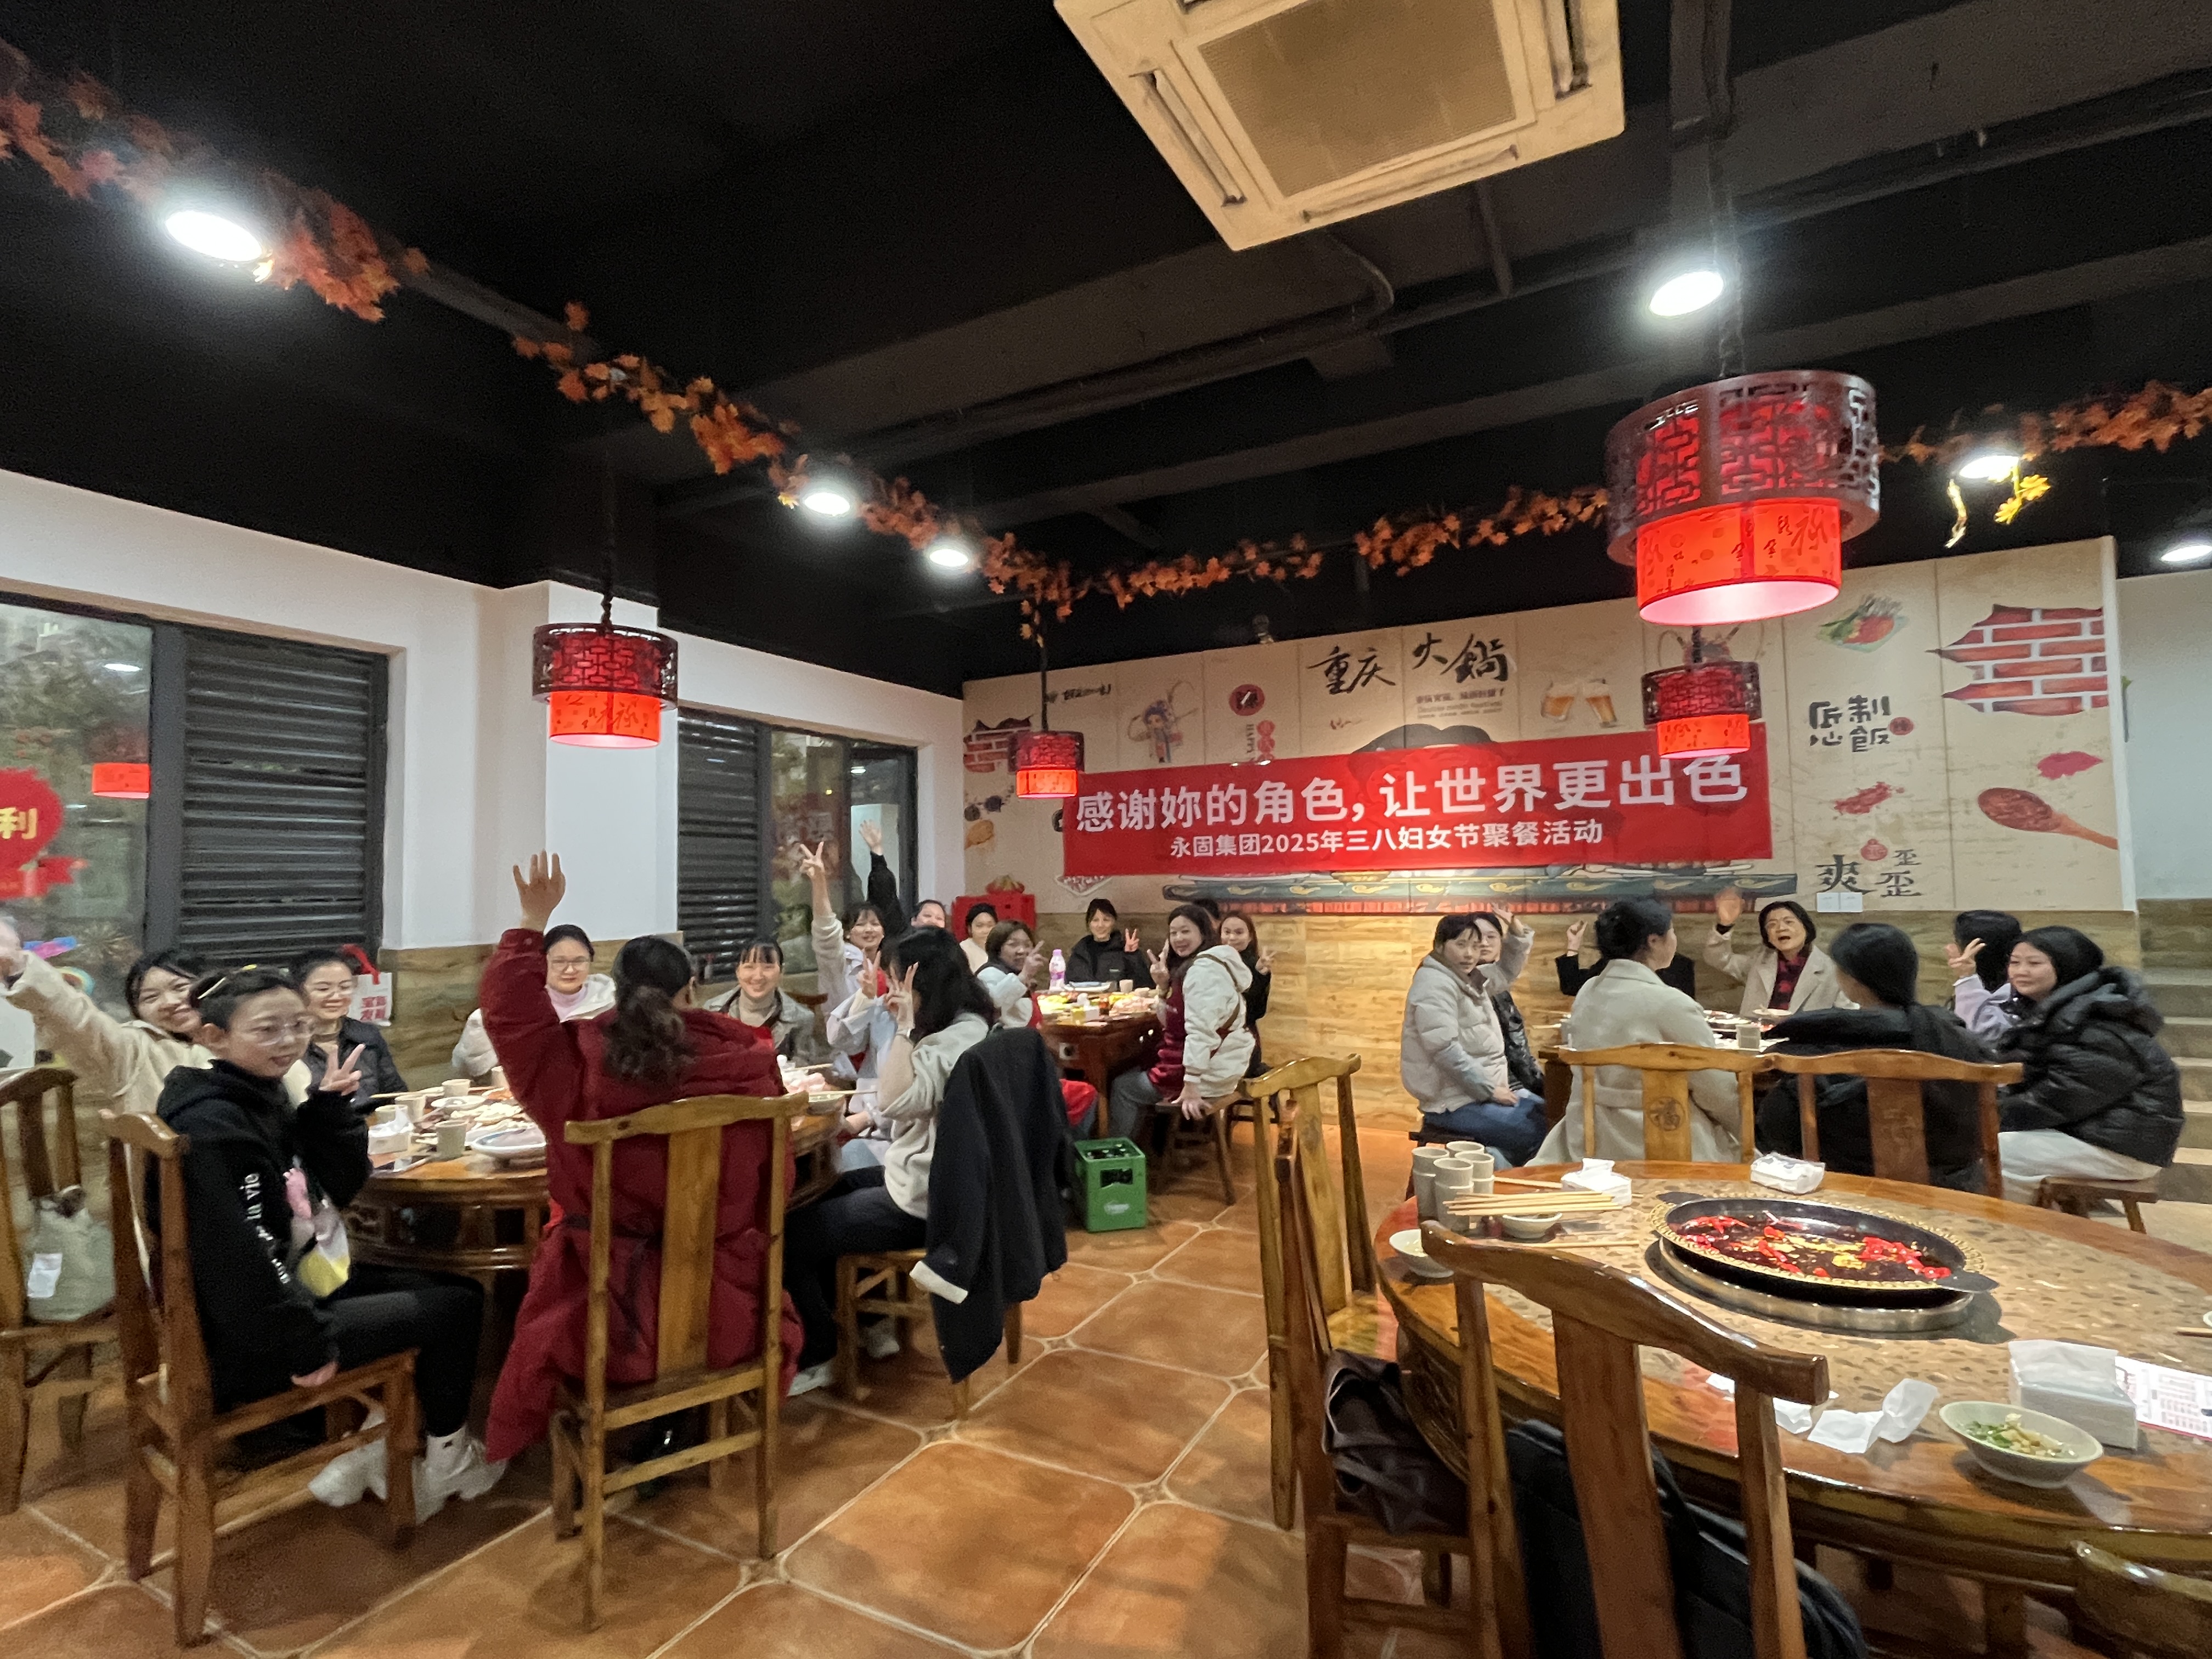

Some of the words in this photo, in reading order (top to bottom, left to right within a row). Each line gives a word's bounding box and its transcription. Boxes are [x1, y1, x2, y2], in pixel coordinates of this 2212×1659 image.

[1170, 819, 1604, 859] 永固集团2025年三八妇女节聚餐活动
